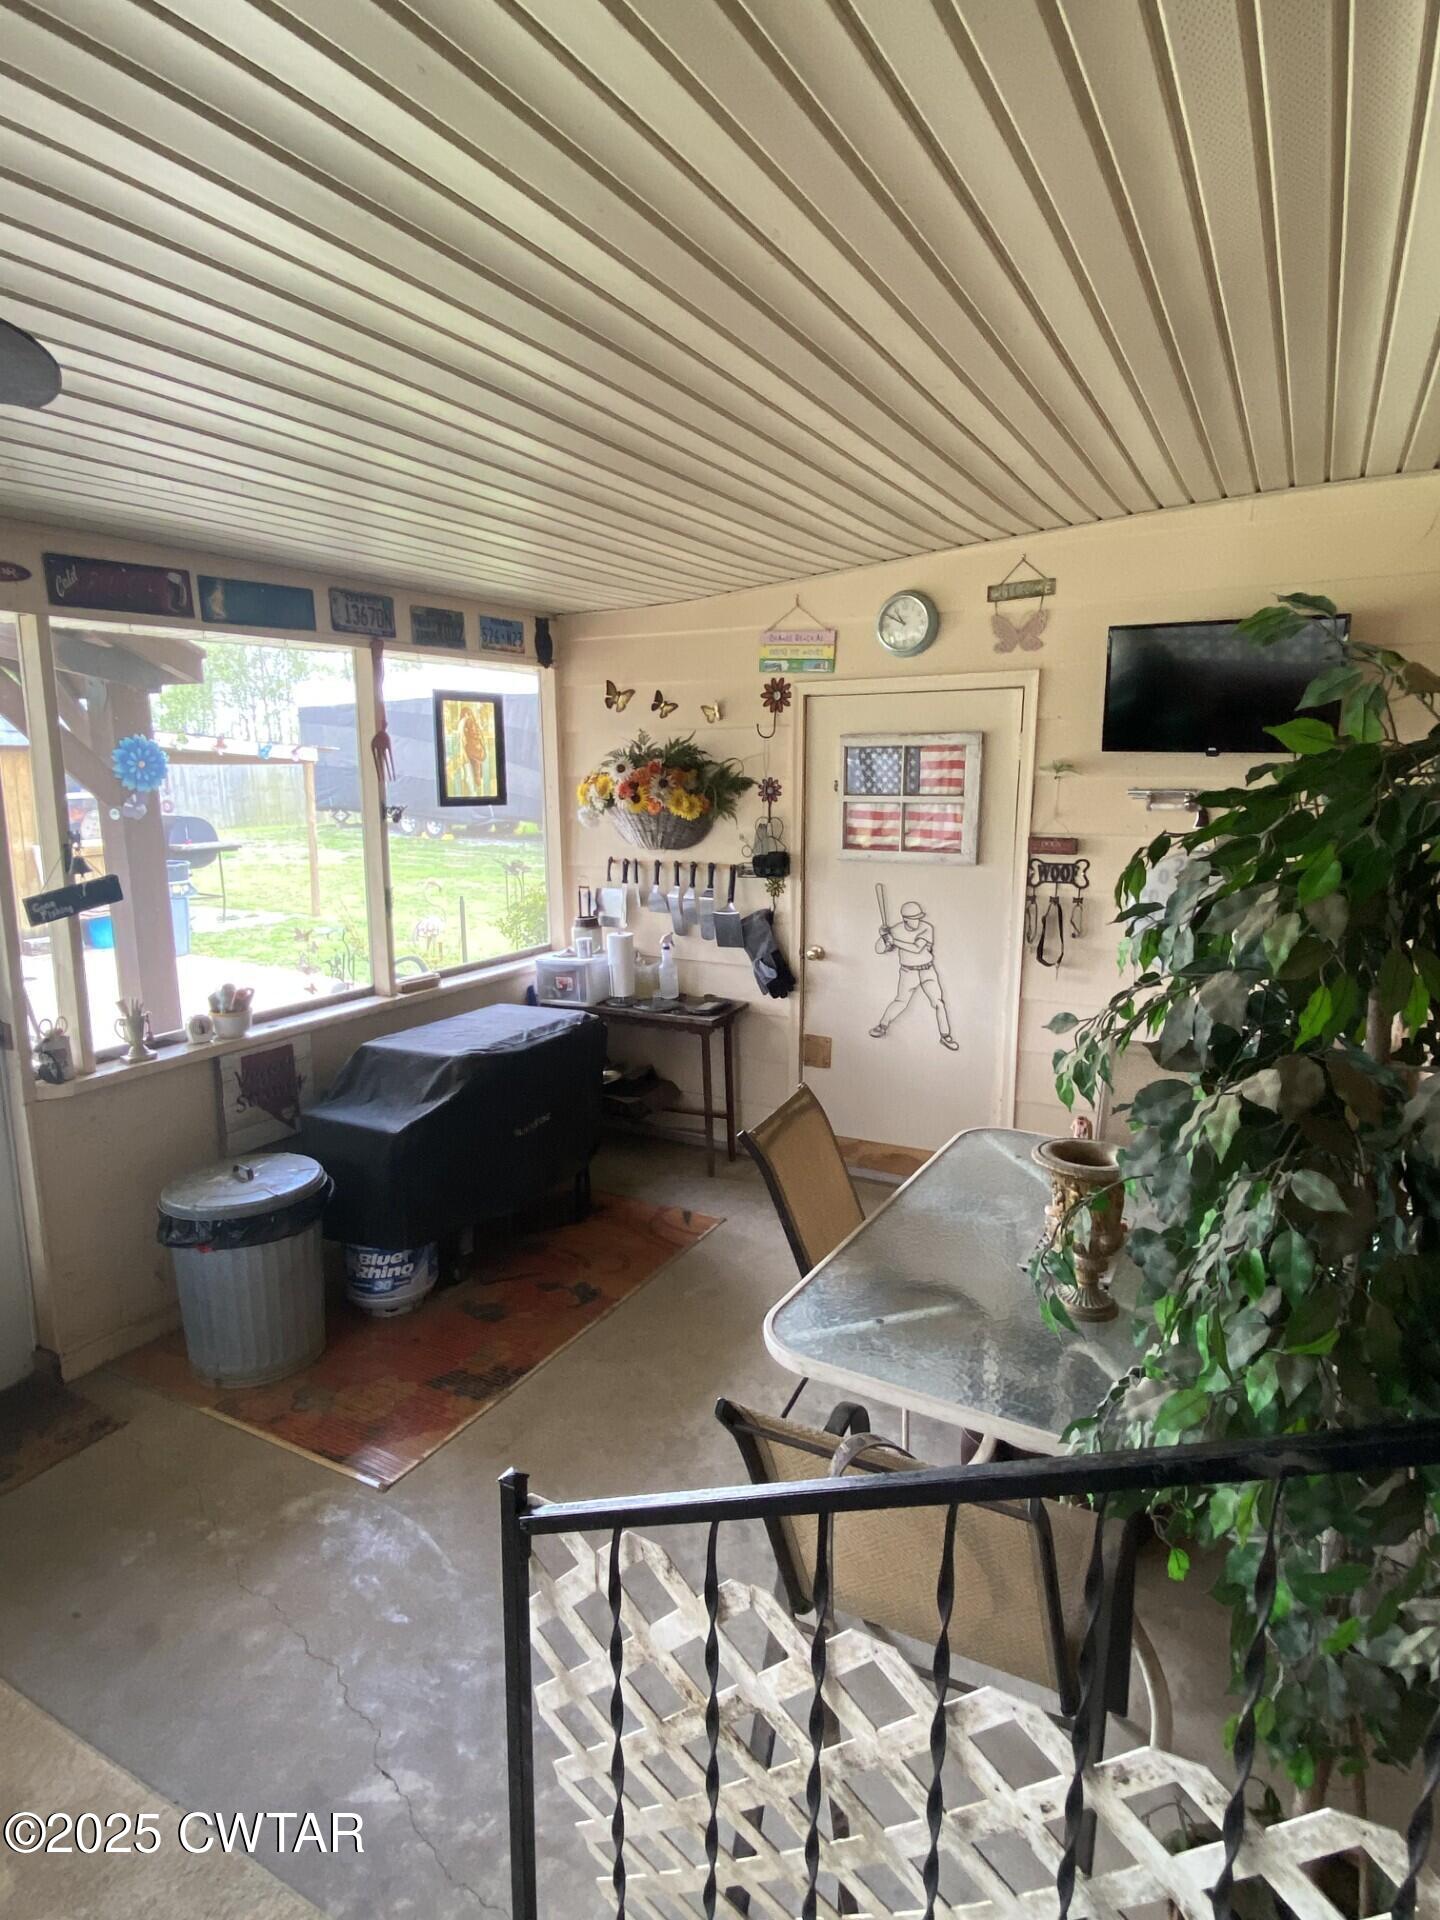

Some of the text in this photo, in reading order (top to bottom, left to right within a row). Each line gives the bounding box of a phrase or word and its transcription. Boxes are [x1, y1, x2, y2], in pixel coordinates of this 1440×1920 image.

[1038, 863, 1080, 882] WOOF
[359, 1252, 403, 1266] Blue
[355, 1262, 414, 1279] Rhino
